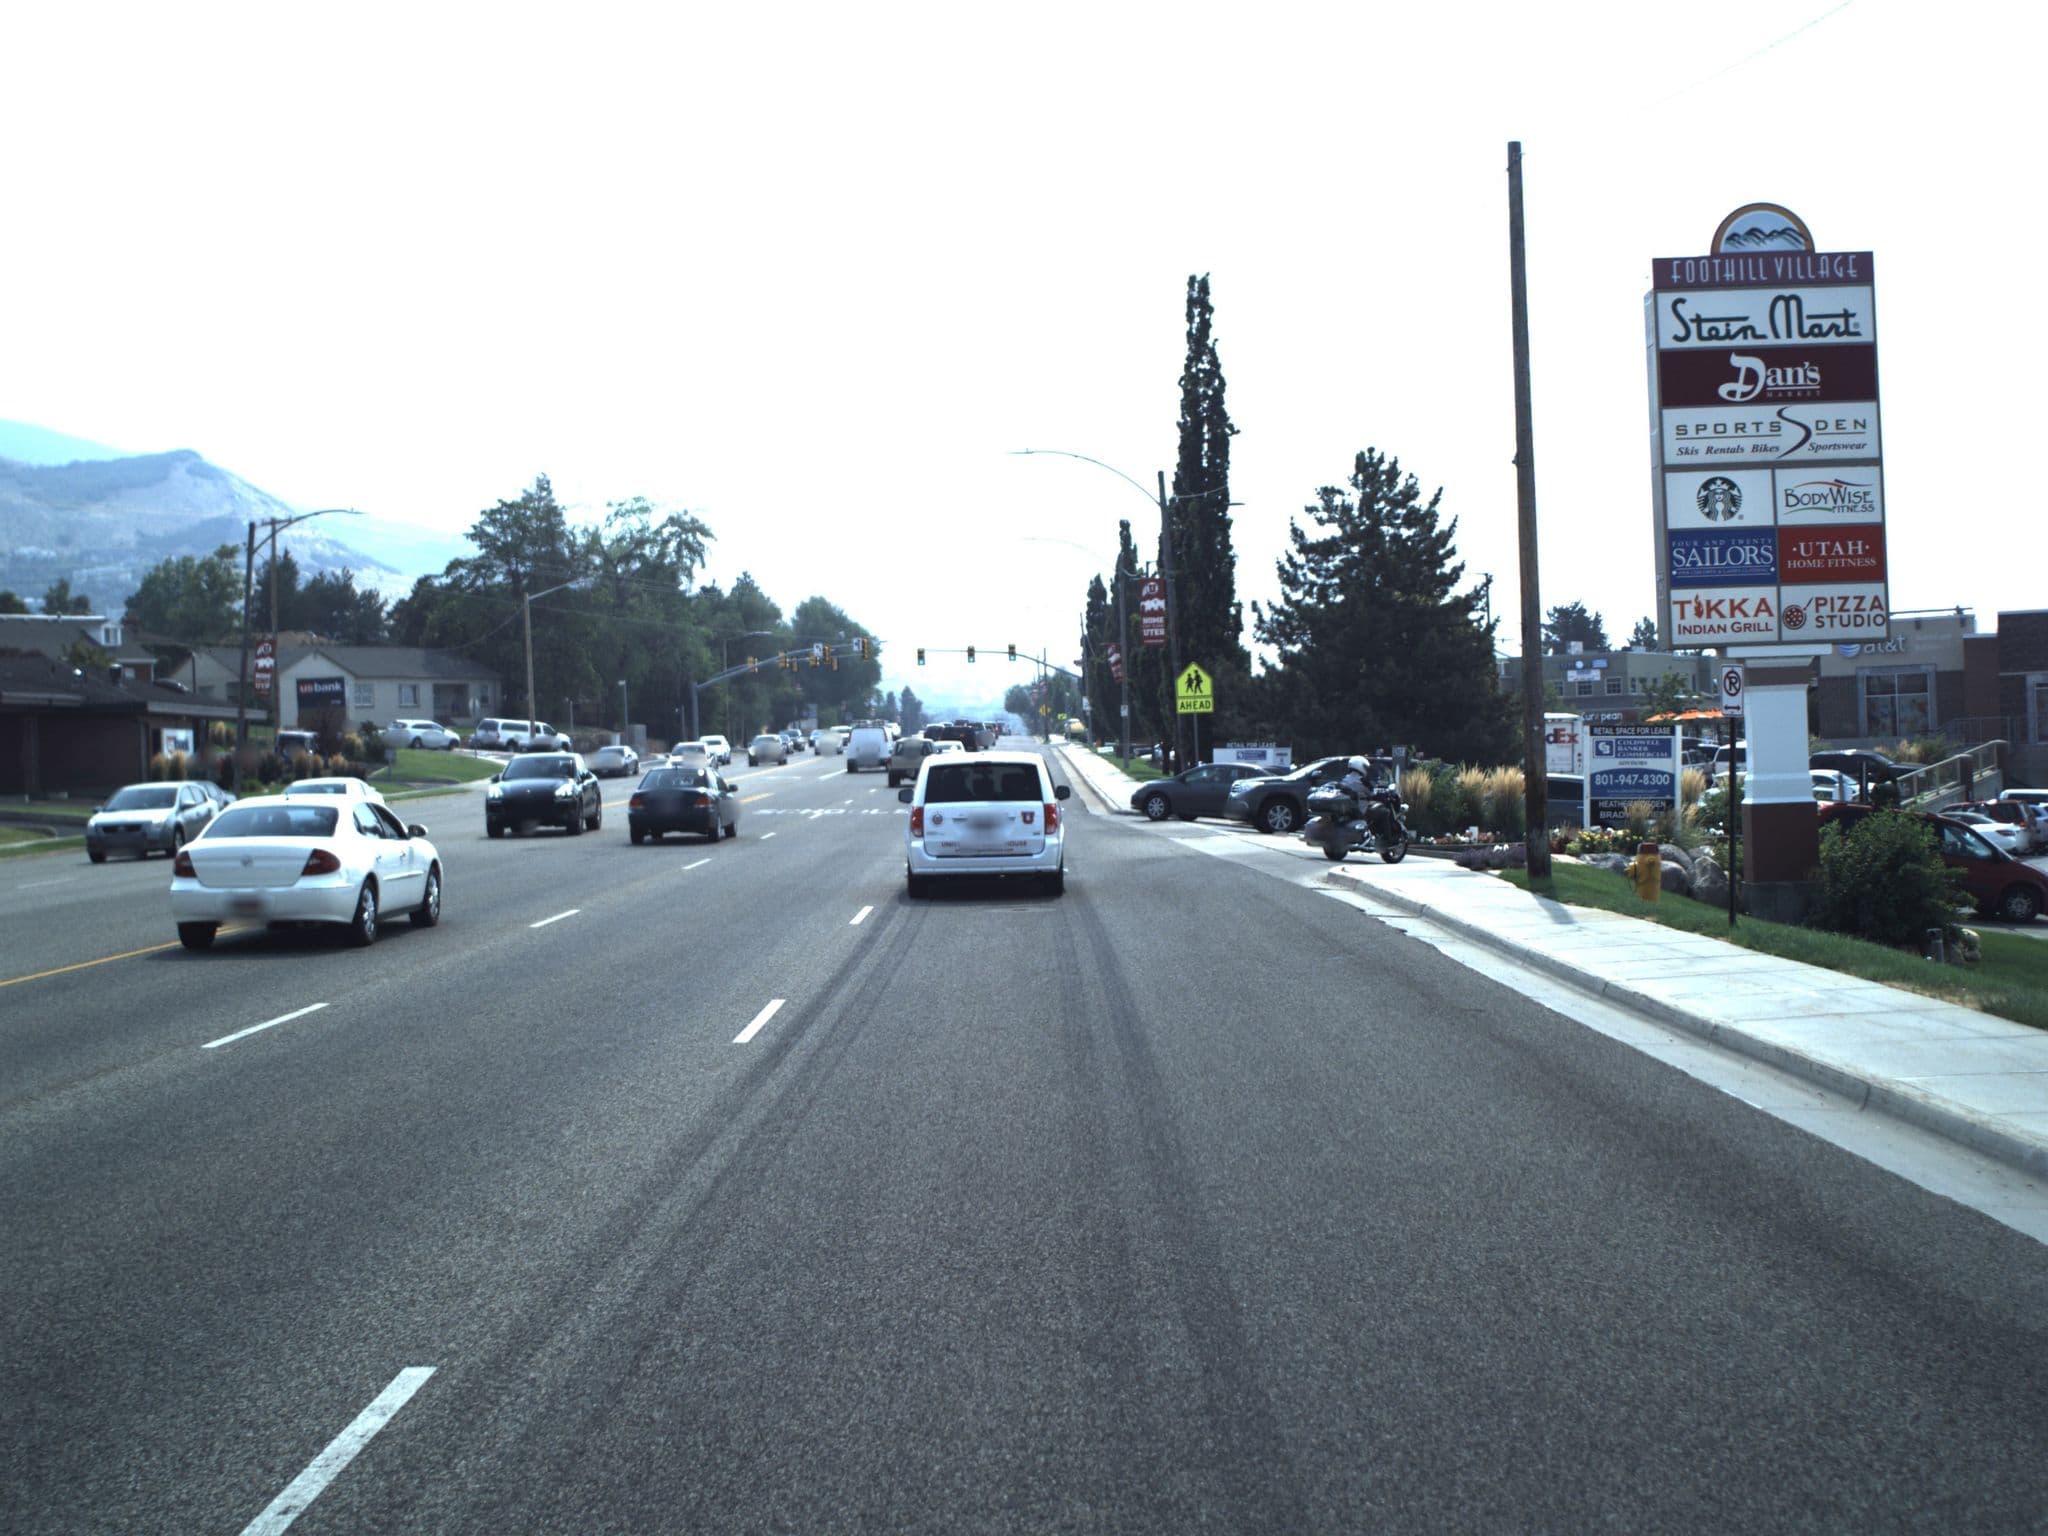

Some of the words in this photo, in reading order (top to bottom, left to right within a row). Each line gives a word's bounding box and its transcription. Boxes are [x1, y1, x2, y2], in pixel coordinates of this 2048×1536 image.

[1671, 257, 1767, 283] FOOTHILL
[1773, 255, 1858, 280] VILLAGE
[1671, 298, 1768, 343] Stein
[1769, 294, 1862, 340] Mart
[1717, 352, 1821, 402] Dan's
[1676, 421, 1782, 436] SPORTS
[1815, 419, 1867, 432] DEN
[1675, 445, 1699, 456] Skis
[1704, 444, 1745, 455] Rentals
[1749, 443, 1780, 453] Bikes
[1806, 440, 1867, 453] Sportswear
[1832, 502, 1875, 514] FITNESS
[1671, 540, 1699, 548] FOUR
[1731, 538, 1772, 546] TWENTY
[1800, 541, 1863, 557] UTAH
[1672, 545, 1774, 568] SAILORS
[1787, 560, 1824, 570] HOME
[1828, 557, 1876, 568] FITNESS
[1815, 595, 1884, 613] PIZZA
[1678, 623, 1727, 635] INDIAN
[1731, 621, 1773, 633] GRILL
[1815, 614, 1886, 629] STUDIO
[1179, 700, 1211, 710] AHEAD
[1594, 727, 1614, 735] RETAIL
[1616, 727, 1636, 735] SPACE
[1637, 727, 1650, 735] FOR
[1651, 727, 1670, 735] LEASE
[1595, 774, 1670, 785] 801-947-8300
